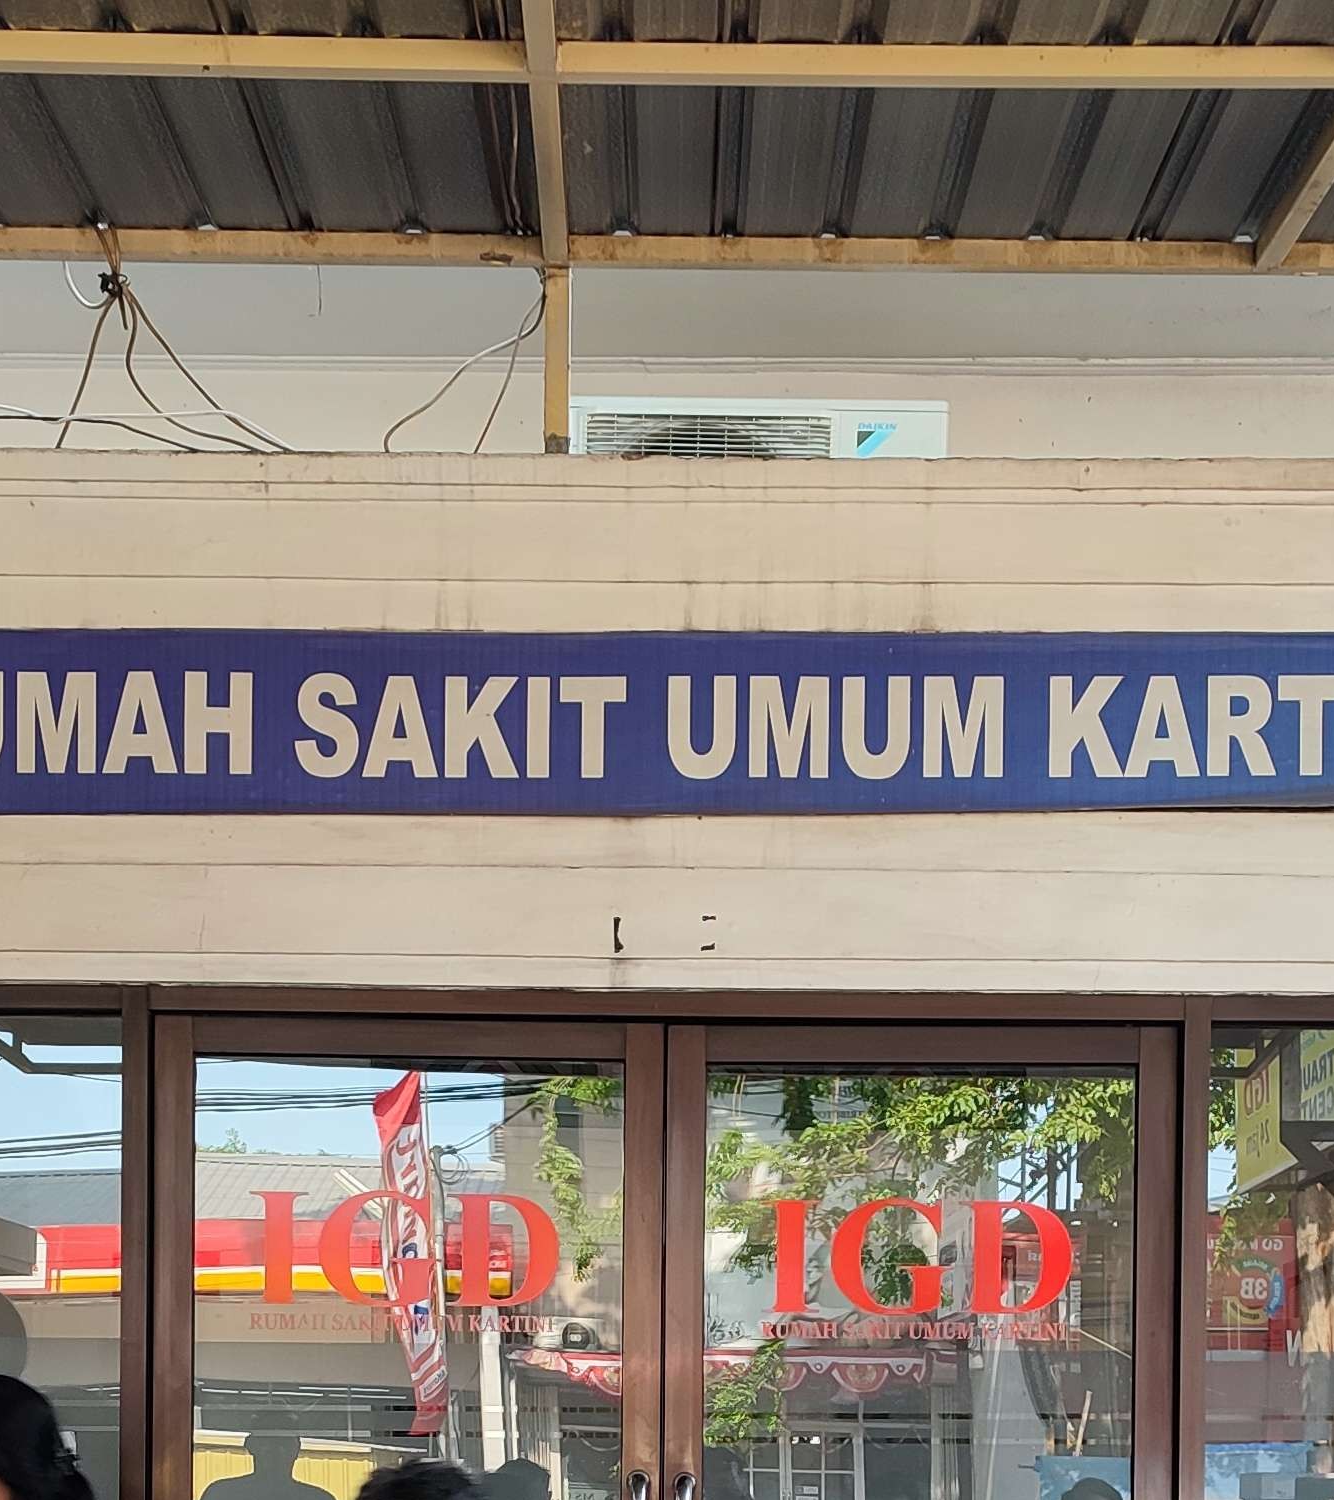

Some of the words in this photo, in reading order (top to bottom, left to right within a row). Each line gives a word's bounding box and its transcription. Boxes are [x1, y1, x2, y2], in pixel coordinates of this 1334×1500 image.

[857, 422, 899, 431] DAIKIN
[295, 671, 627, 779] SAKIT
[665, 672, 1006, 781] UMUM
[249, 1188, 560, 1308] IGD
[761, 1196, 1073, 1316] IGD
[468, 1315, 555, 1333] KARTINI
[760, 1321, 837, 1340] RUMAH
[906, 1321, 974, 1340] UMUM
